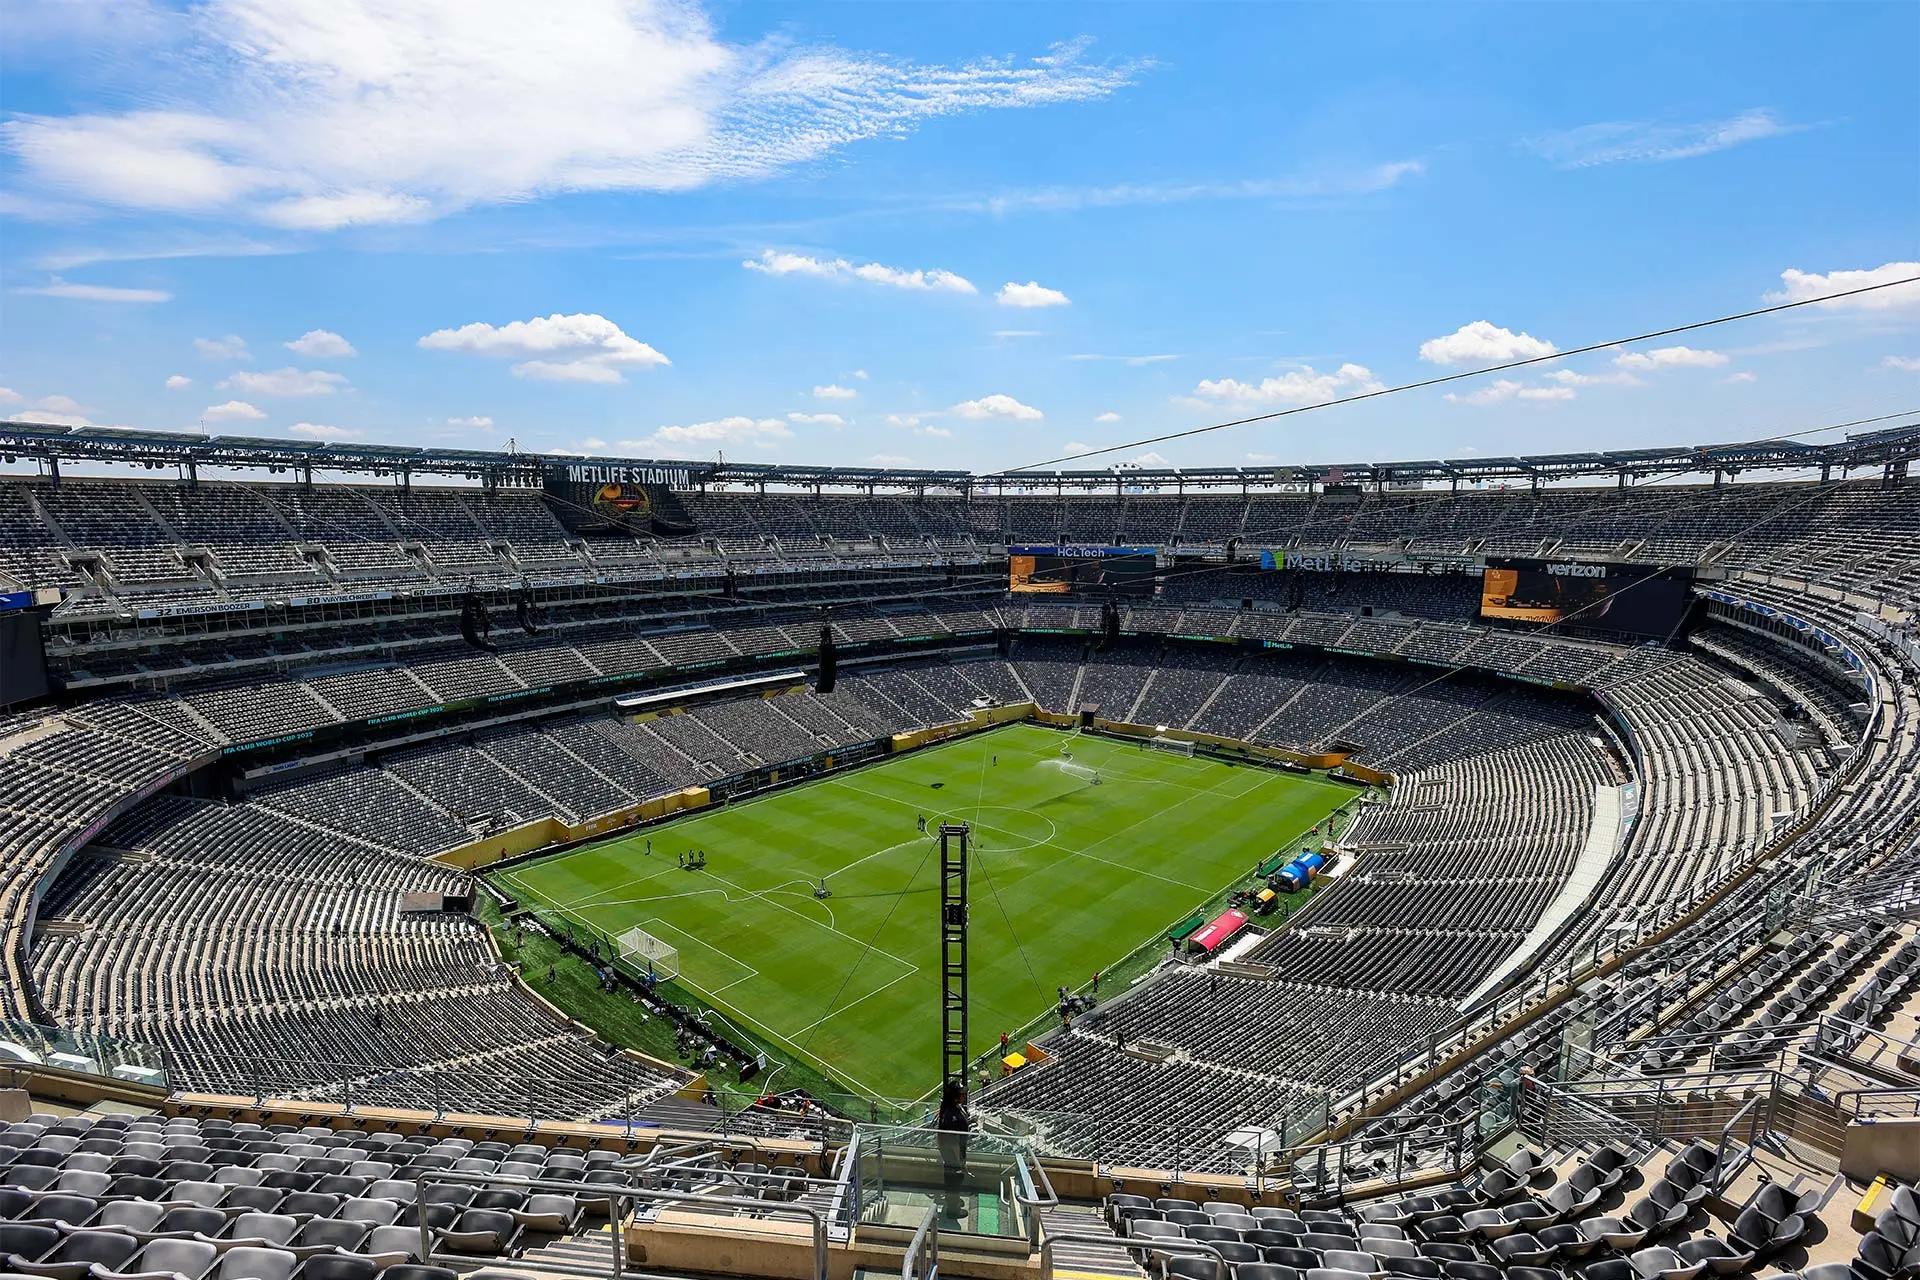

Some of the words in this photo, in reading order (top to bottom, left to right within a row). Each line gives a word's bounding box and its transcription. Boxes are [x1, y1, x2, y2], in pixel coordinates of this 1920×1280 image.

[569, 465, 628, 483] METLIFE
[632, 467, 690, 485] STADIUM
[1058, 548, 1104, 557] HCLTech
[1546, 562, 1606, 578] verizon
[176, 606, 218, 614] EMERSON
[218, 603, 250, 611] BOOZER
[397, 711, 417, 719] WORLD
[236, 742, 255, 751] CLUB
[256, 738, 281, 747] WORLD
